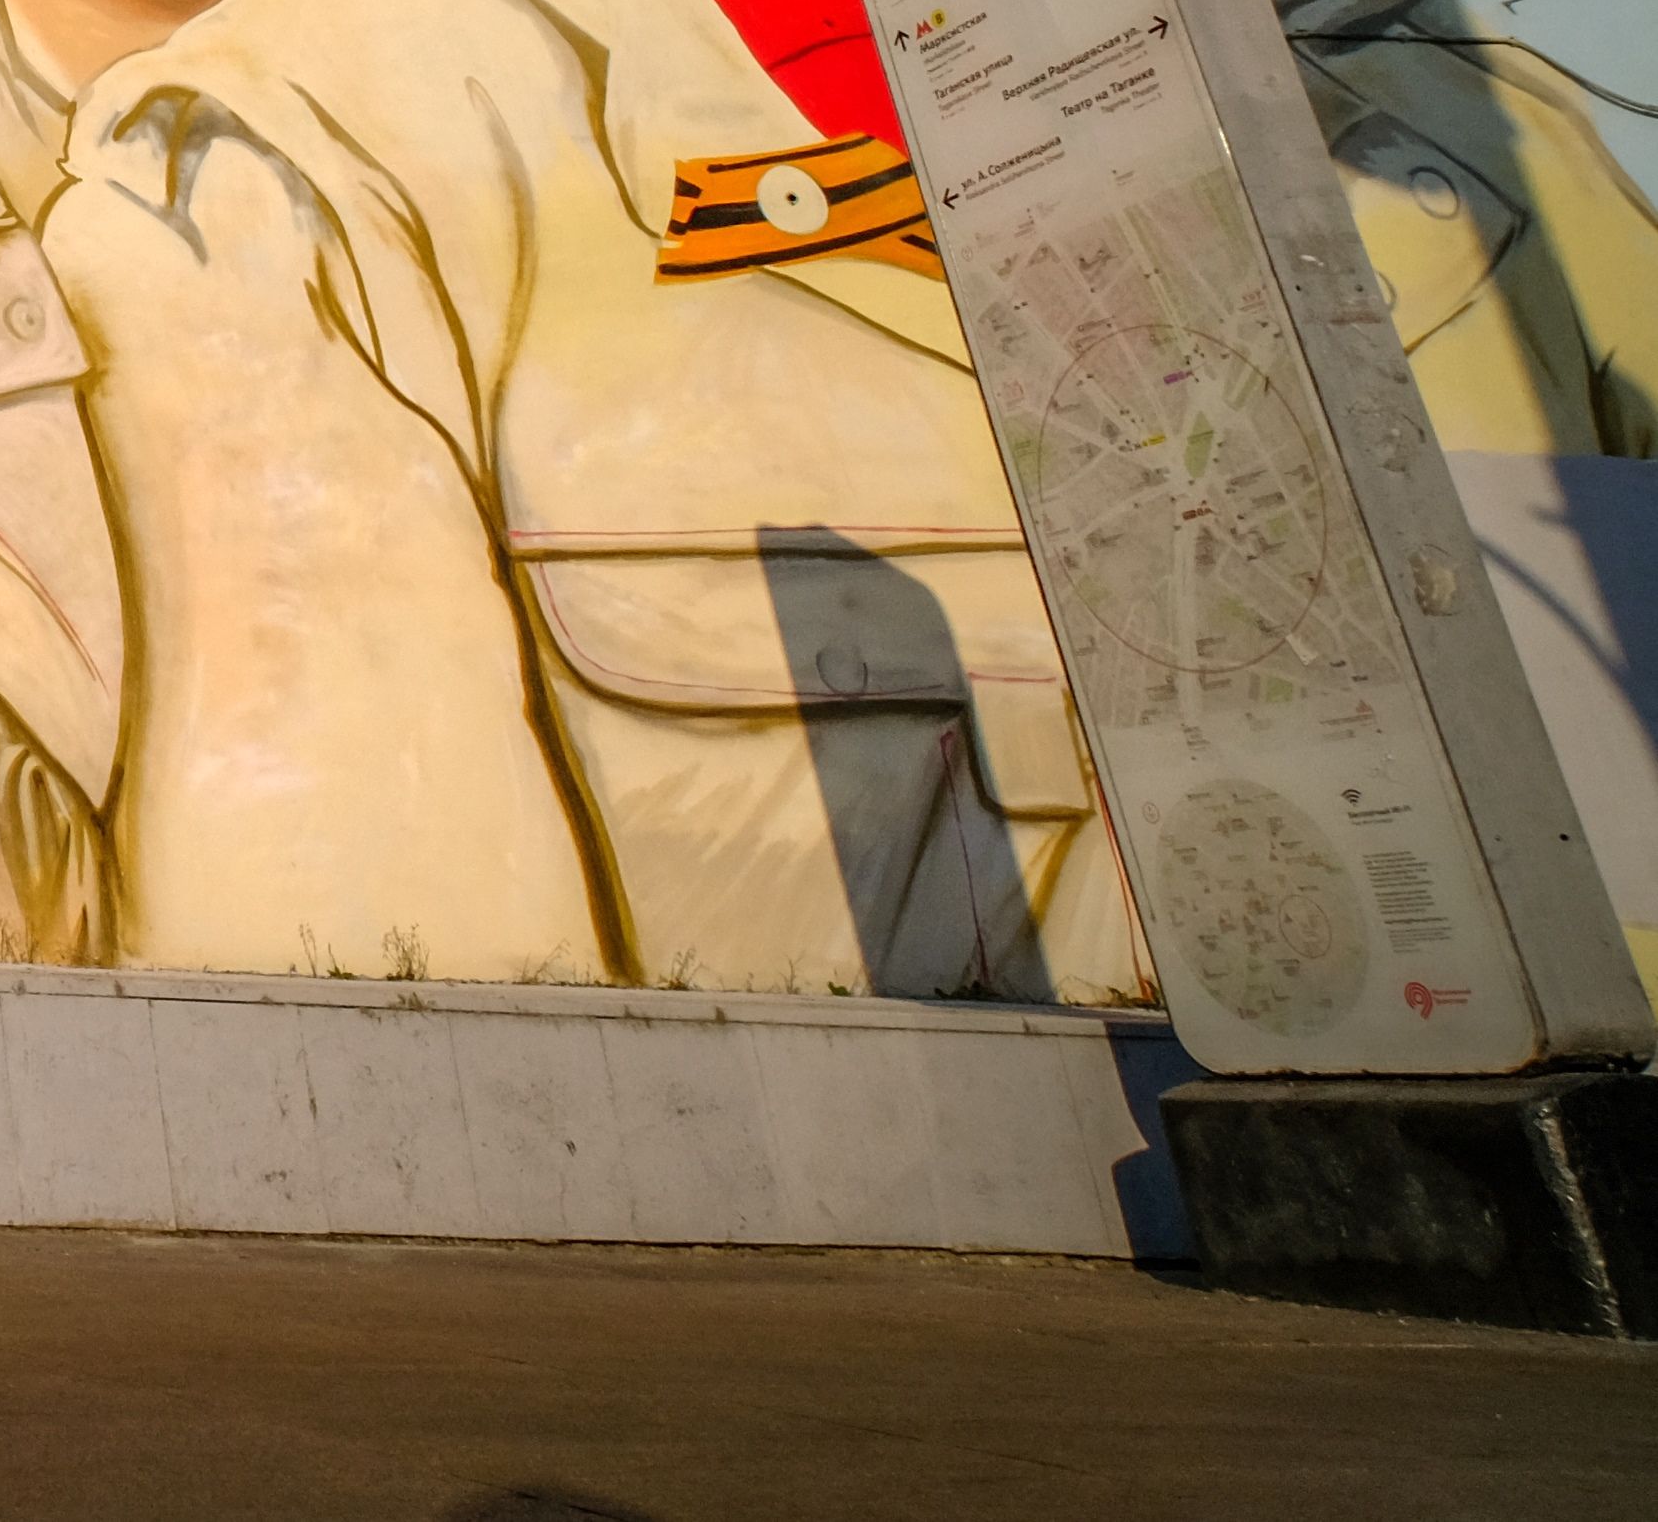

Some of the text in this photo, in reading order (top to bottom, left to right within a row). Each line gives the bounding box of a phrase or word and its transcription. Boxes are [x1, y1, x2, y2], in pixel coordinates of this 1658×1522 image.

[919, 12, 988, 54] Марксистская
[934, 71, 982, 100] Таганская
[983, 54, 1014, 78] улица
[1002, 72, 1047, 101] Верхняя
[1060, 97, 1094, 118] Театр
[1095, 90, 1109, 104] на
[1109, 67, 1156, 95] Таганке
